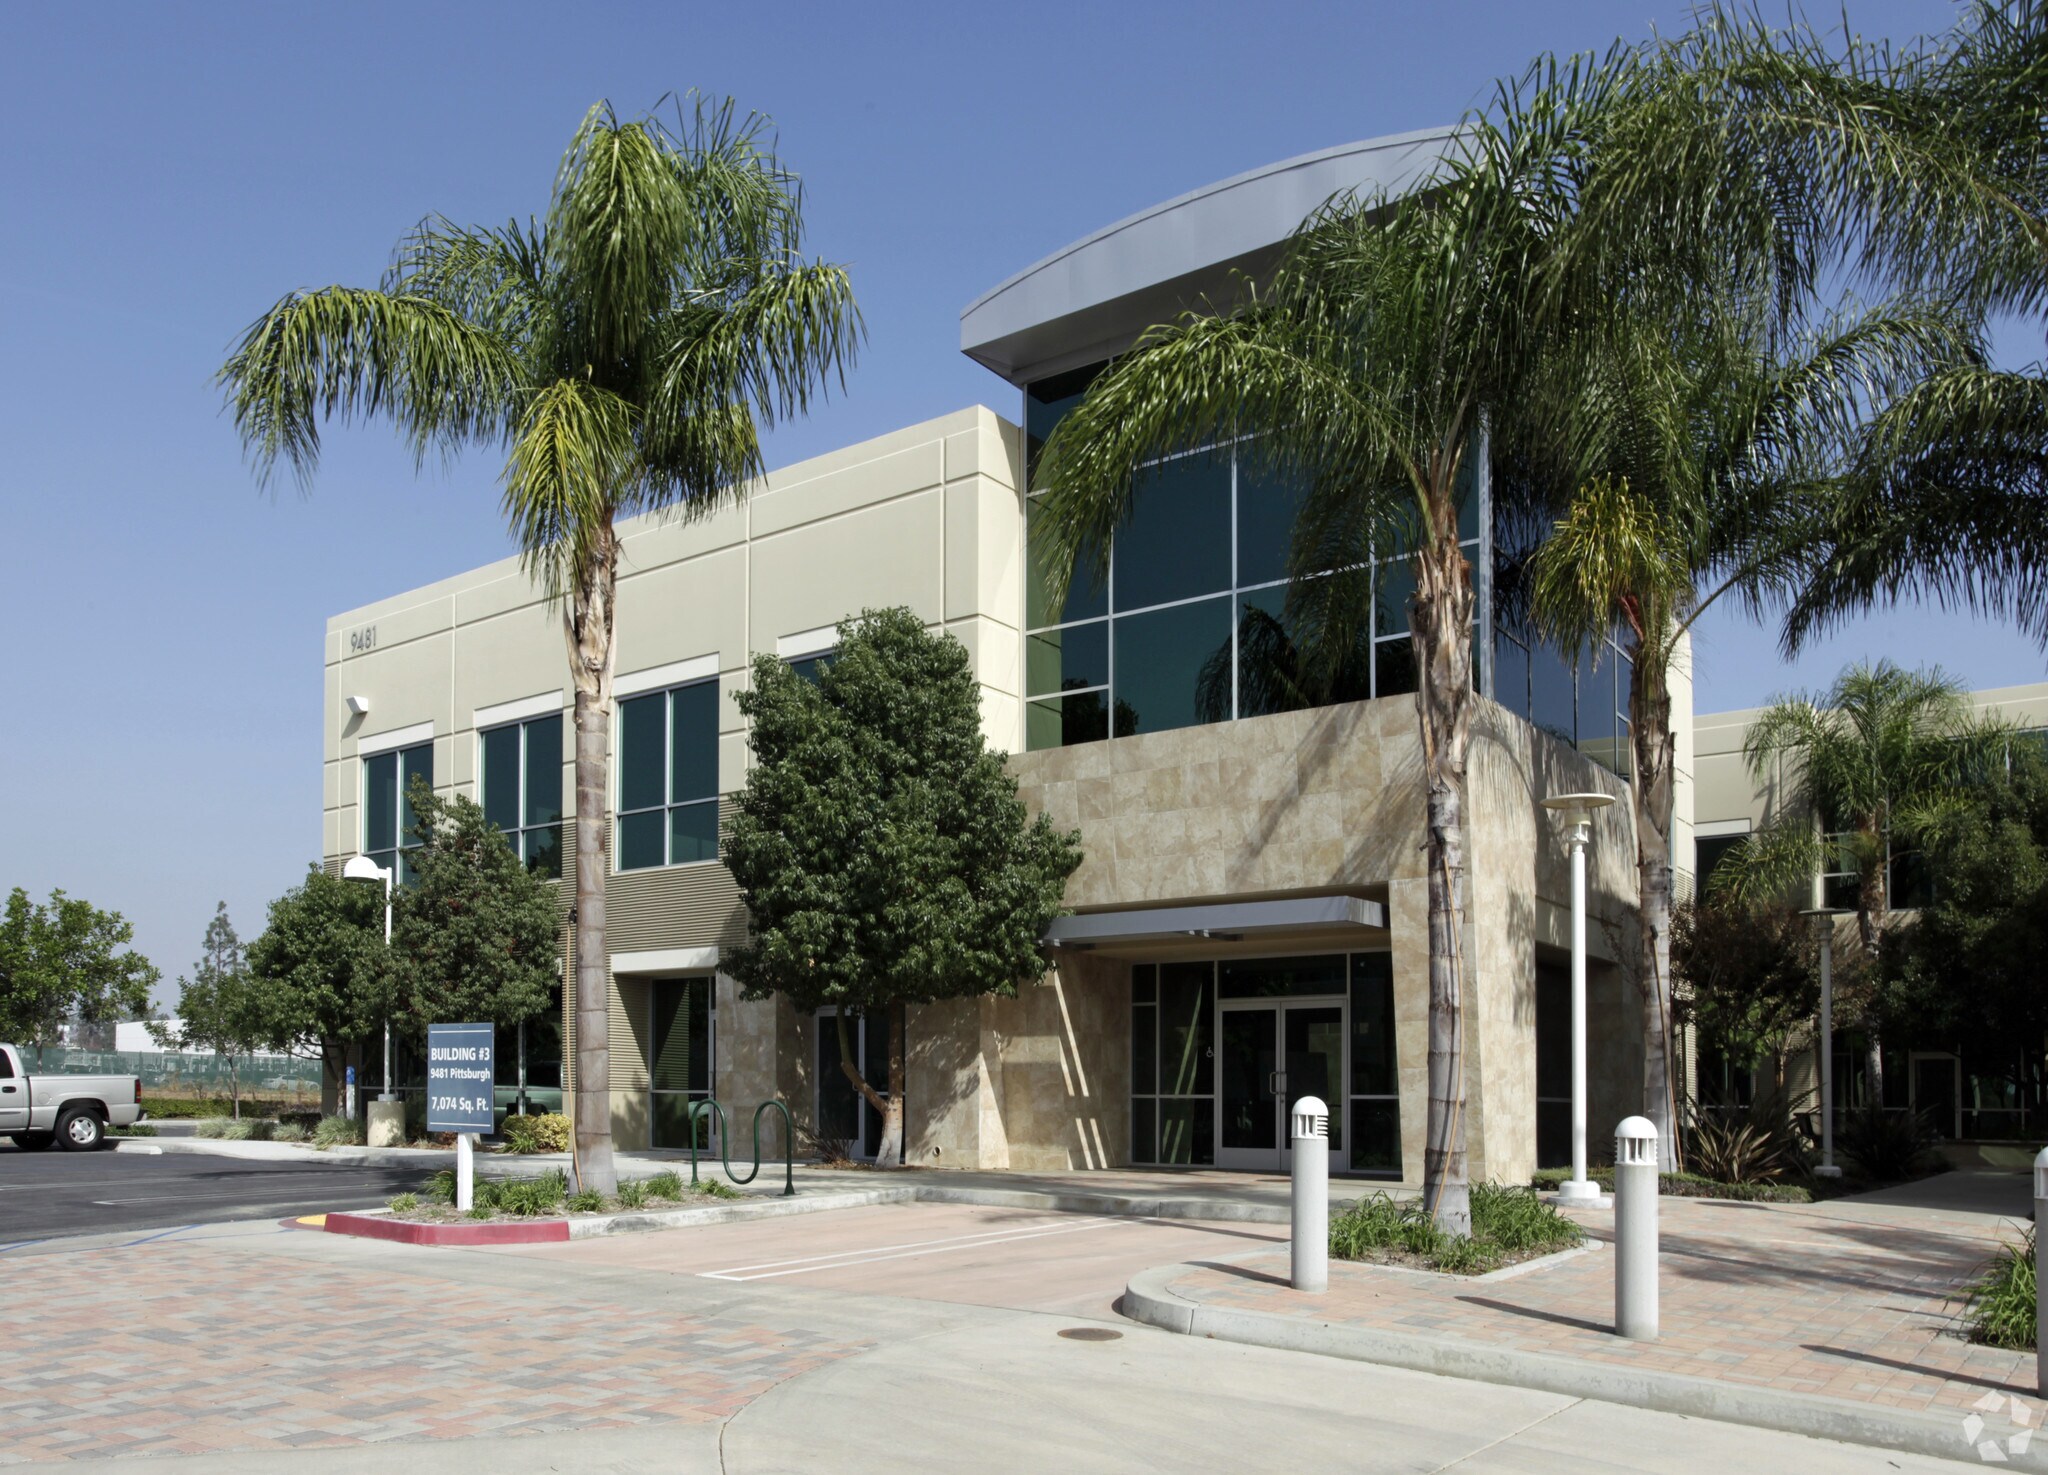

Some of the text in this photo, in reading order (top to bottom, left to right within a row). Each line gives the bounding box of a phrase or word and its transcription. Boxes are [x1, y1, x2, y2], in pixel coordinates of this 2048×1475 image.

[351, 625, 376, 653] 9481
[431, 1048, 490, 1060] BUILDING #3
[430, 1068, 490, 1081] 9481 Pittsburgh
[432, 1097, 489, 1114] 7,074 Sq. Ft.
